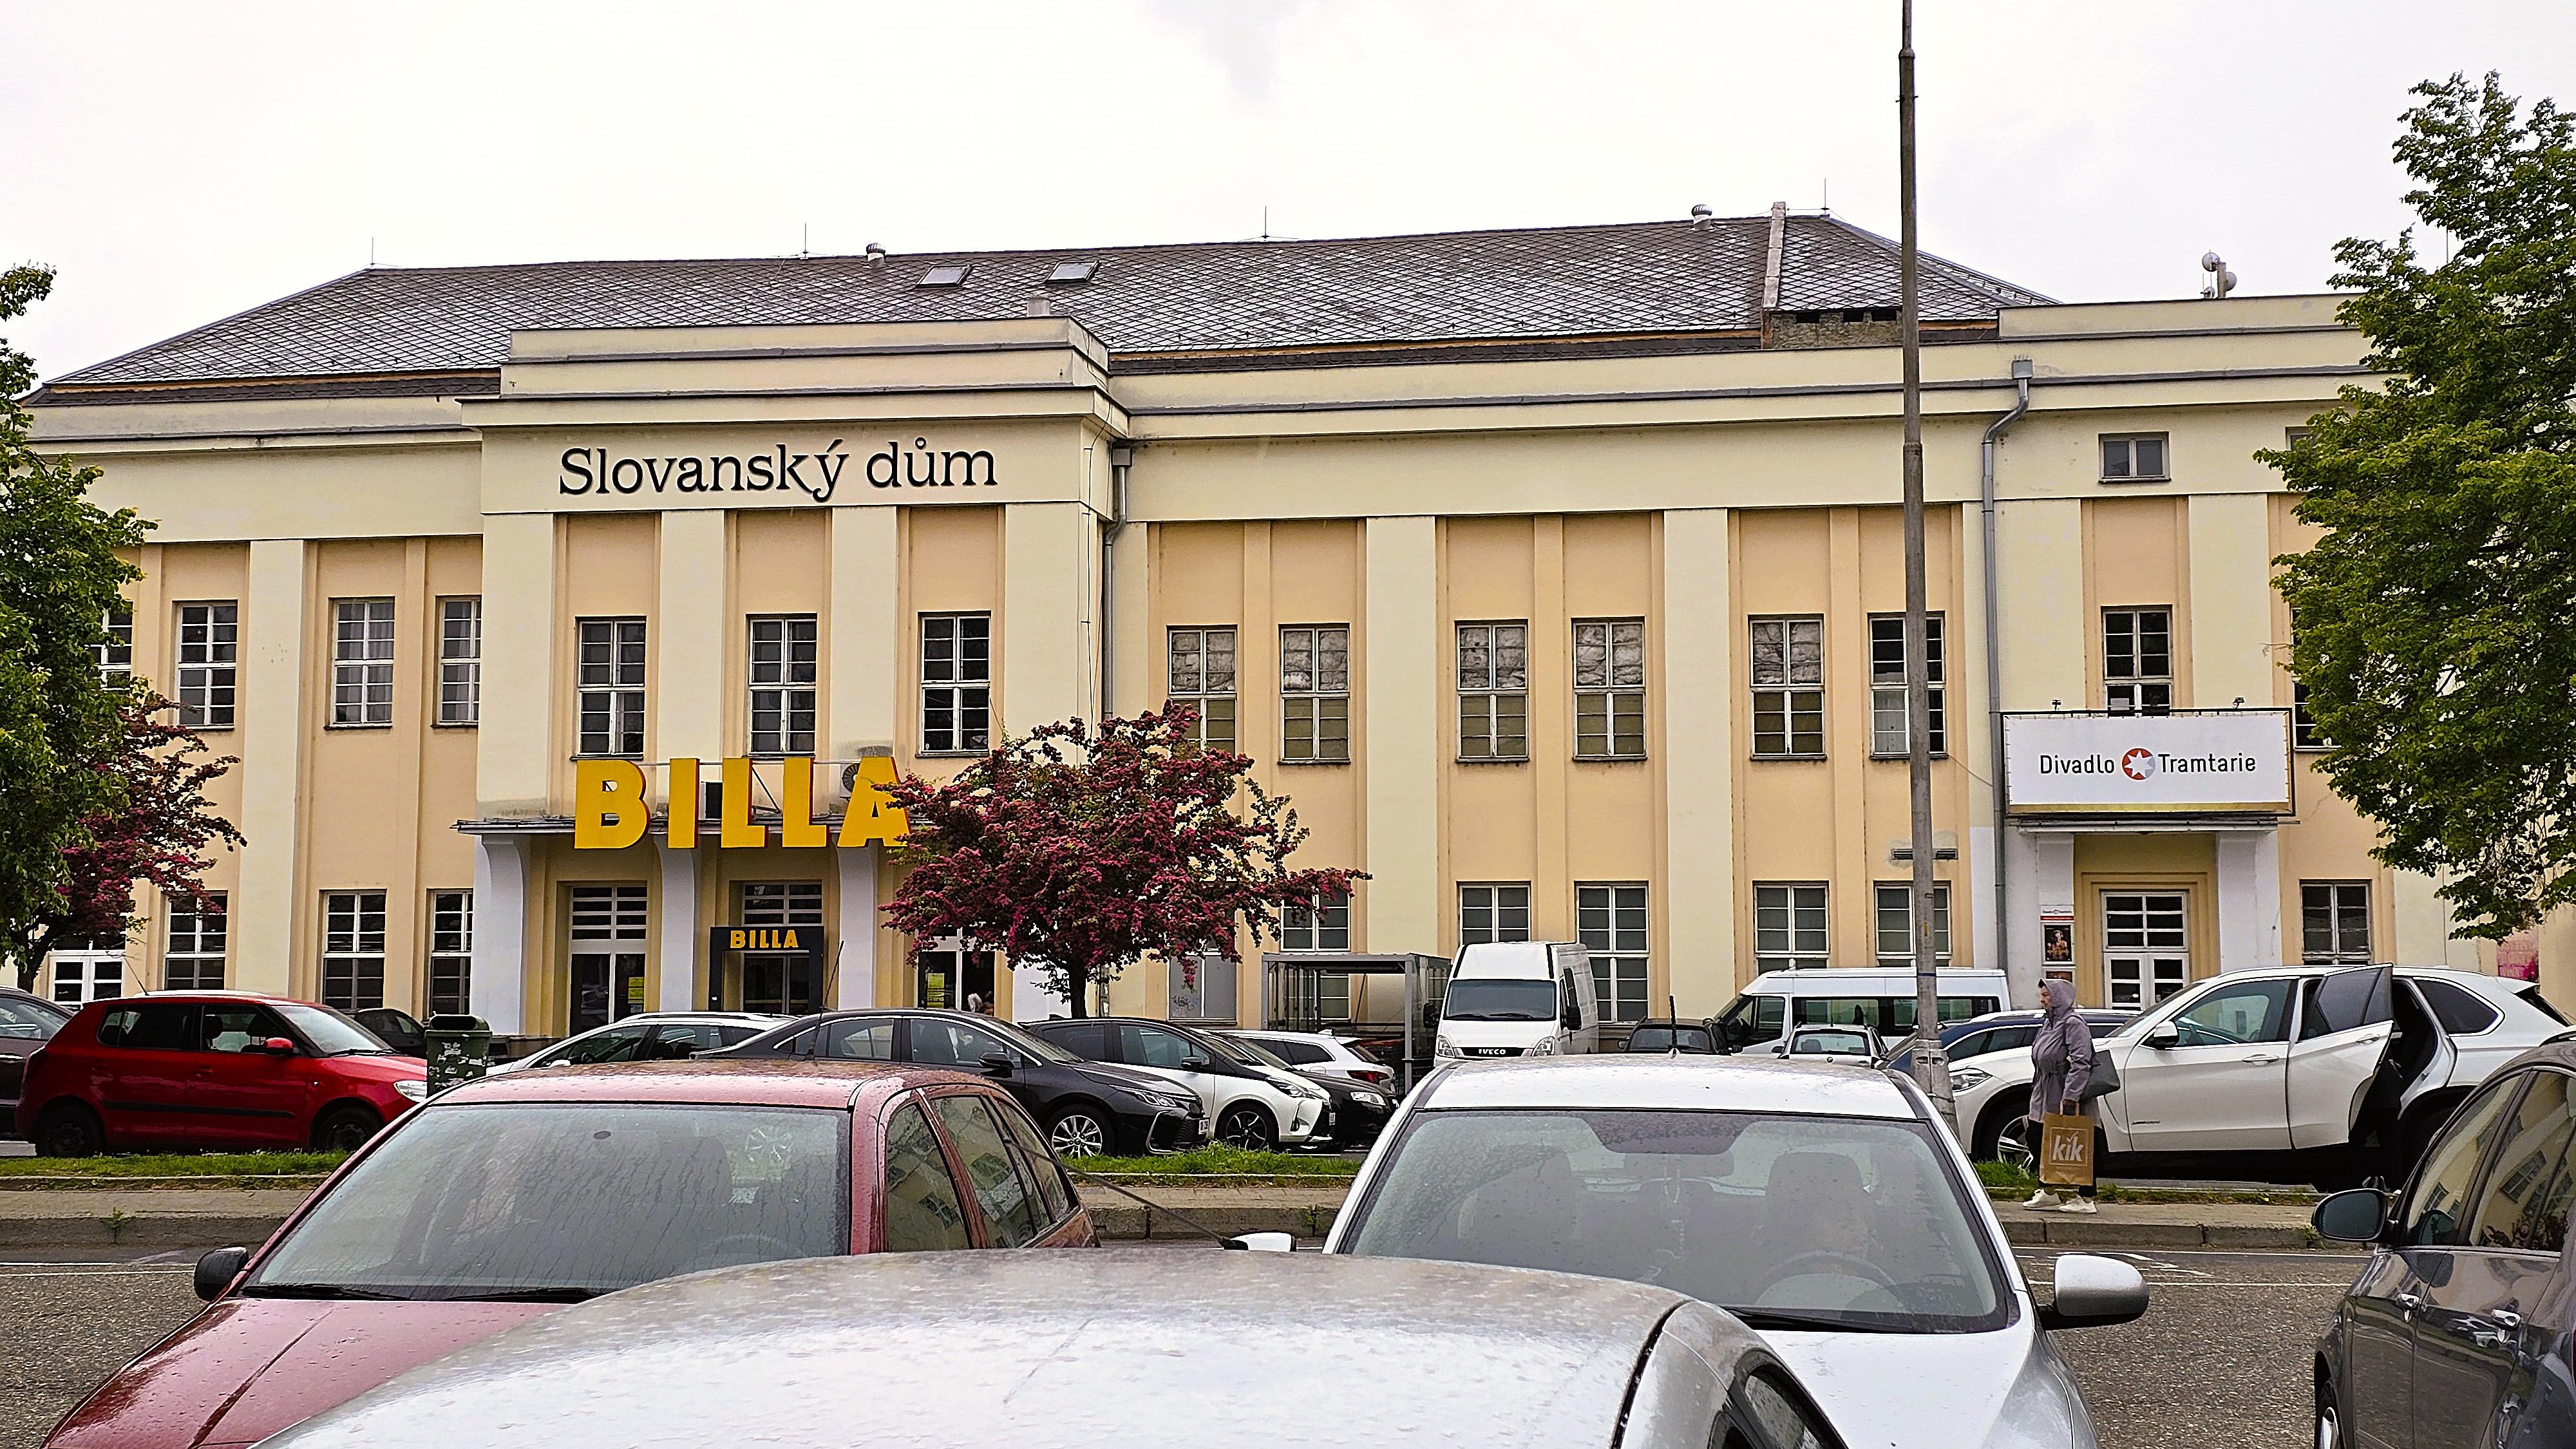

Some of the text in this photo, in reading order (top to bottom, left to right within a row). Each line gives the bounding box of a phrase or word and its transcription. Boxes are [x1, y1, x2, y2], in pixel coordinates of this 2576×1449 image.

[559, 437, 998, 503] Slovanský dům
[2040, 752, 2256, 774] Divadlo Tramtarie
[574, 756, 910, 849] BILLA
[730, 931, 799, 948] BILLA
